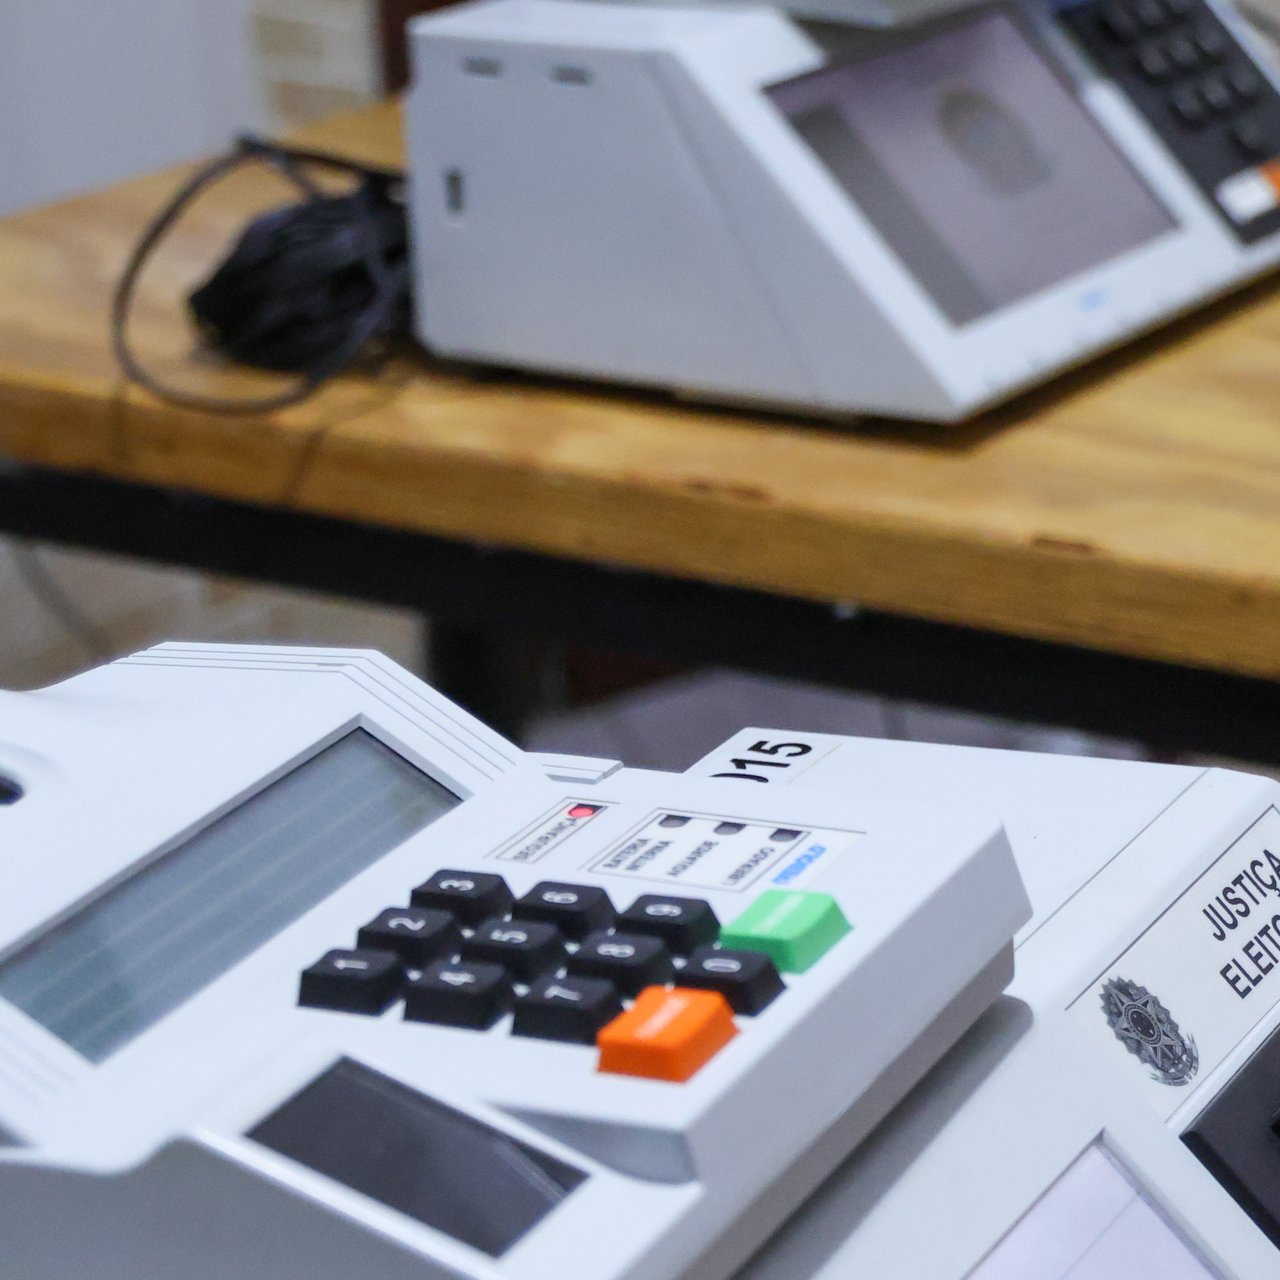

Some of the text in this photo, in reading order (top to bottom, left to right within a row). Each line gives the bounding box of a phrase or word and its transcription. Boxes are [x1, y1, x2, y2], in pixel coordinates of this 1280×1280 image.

[439, 880, 475, 891] 3
[542, 891, 578, 904] 6
[645, 904, 682, 917] 9
[388, 917, 426, 931] 2
[490, 929, 528, 944] 5
[597, 943, 636, 958] 8
[334, 958, 368, 970] 1
[544, 985, 582, 1001] 7
